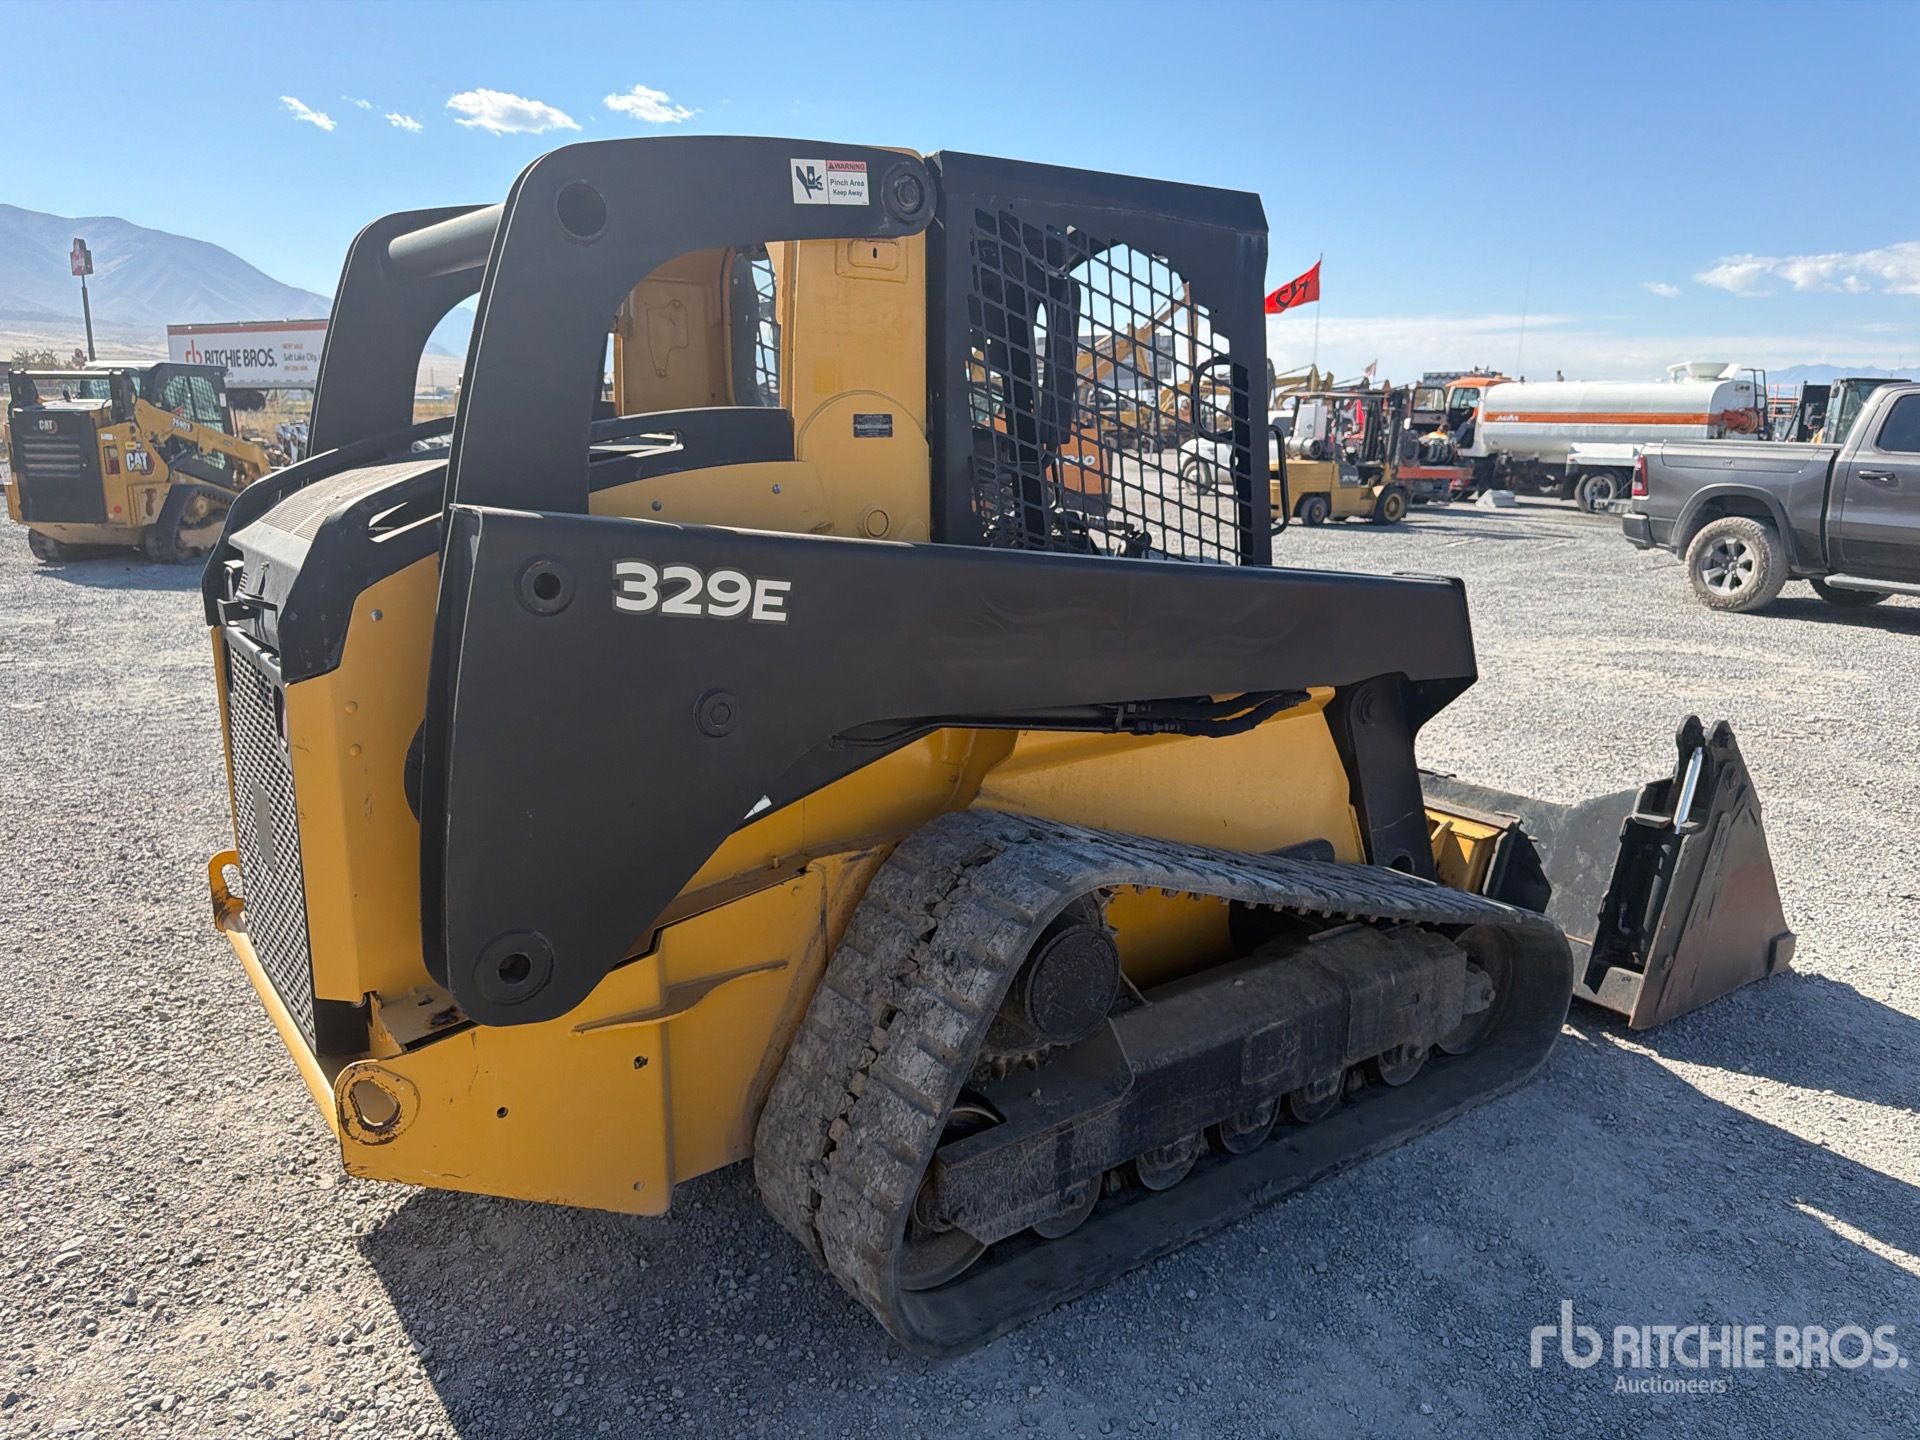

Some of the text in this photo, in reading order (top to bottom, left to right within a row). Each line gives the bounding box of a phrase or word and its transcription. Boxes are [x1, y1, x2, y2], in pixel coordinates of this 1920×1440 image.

[834, 162, 865, 170] WARNING
[830, 179, 865, 187] Pinch Area
[833, 189, 863, 197] Keep Away
[204, 348, 278, 368] RITCHIE BROS.
[39, 420, 53, 431] CAT
[126, 452, 148, 472] CAT
[614, 560, 793, 622] 329E
